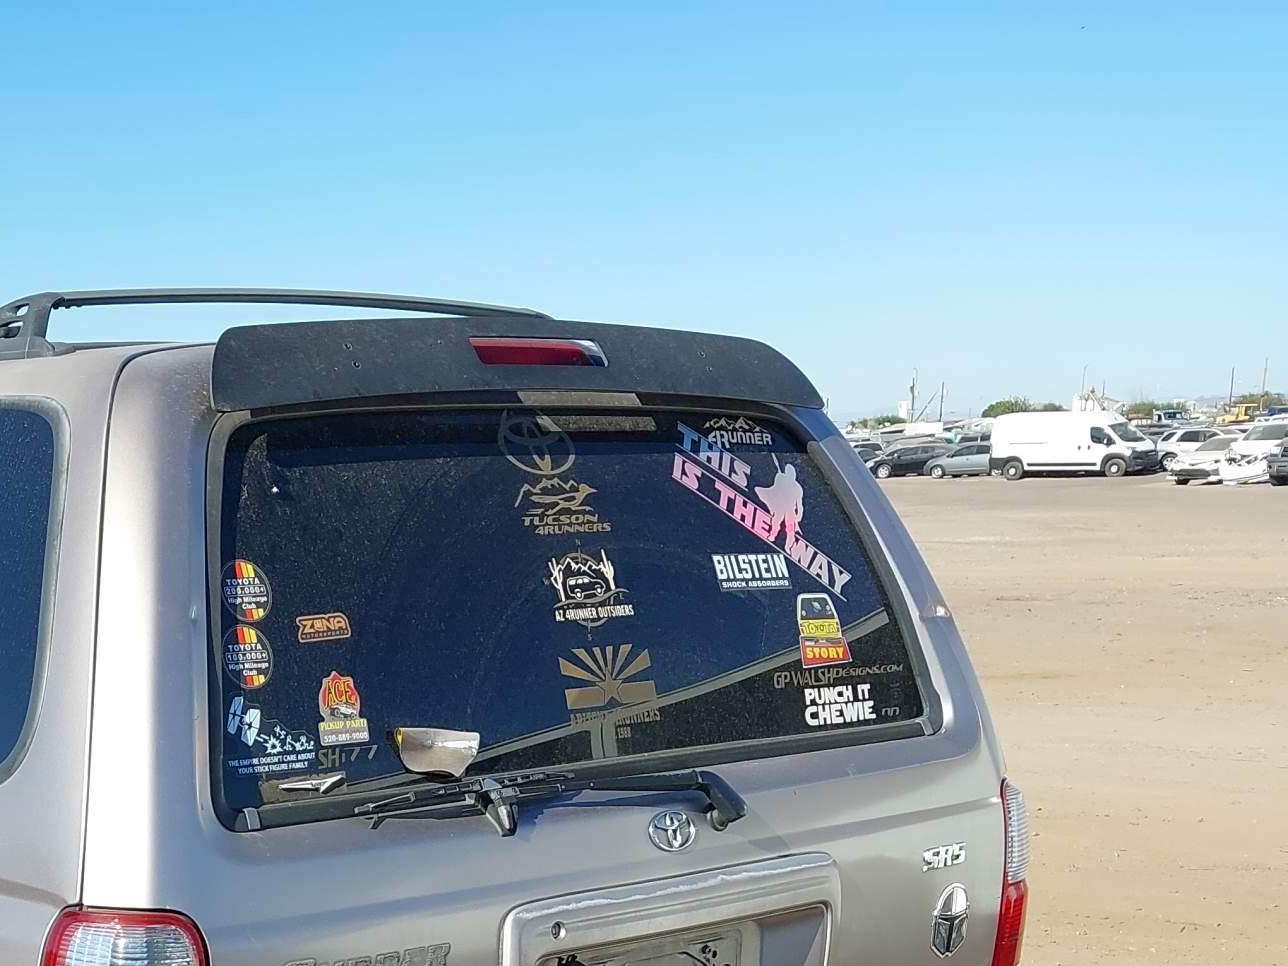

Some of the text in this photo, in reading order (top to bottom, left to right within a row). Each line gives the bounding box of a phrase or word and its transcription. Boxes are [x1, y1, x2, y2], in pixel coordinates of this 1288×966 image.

[678, 424, 752, 489] THIS
[521, 513, 599, 526] TUCSON
[672, 454, 852, 594] IS THE WAY
[535, 522, 612, 535] 4RUNNERS
[713, 553, 789, 581] BILSTEIN
[225, 578, 261, 586] TOYOTA
[721, 579, 789, 589] SHOCK ABSORBERS
[555, 604, 635, 621] AZ 4RUNNER OUTSIDERS
[801, 622, 838, 635] TOYOTA
[227, 643, 263, 652] TOYOTA
[806, 646, 844, 659] STORY
[803, 683, 871, 706] PUNCH IT
[804, 700, 877, 726] CHEWIE
[320, 721, 345, 731] PICKUP
[227, 759, 239, 767] THE
[283, 753, 297, 762] CARE
[298, 751, 316, 760] ABOUT
[237, 761, 309, 775] YOUR STICK FIGURE FAMILY
[922, 841, 968, 873] SR5
